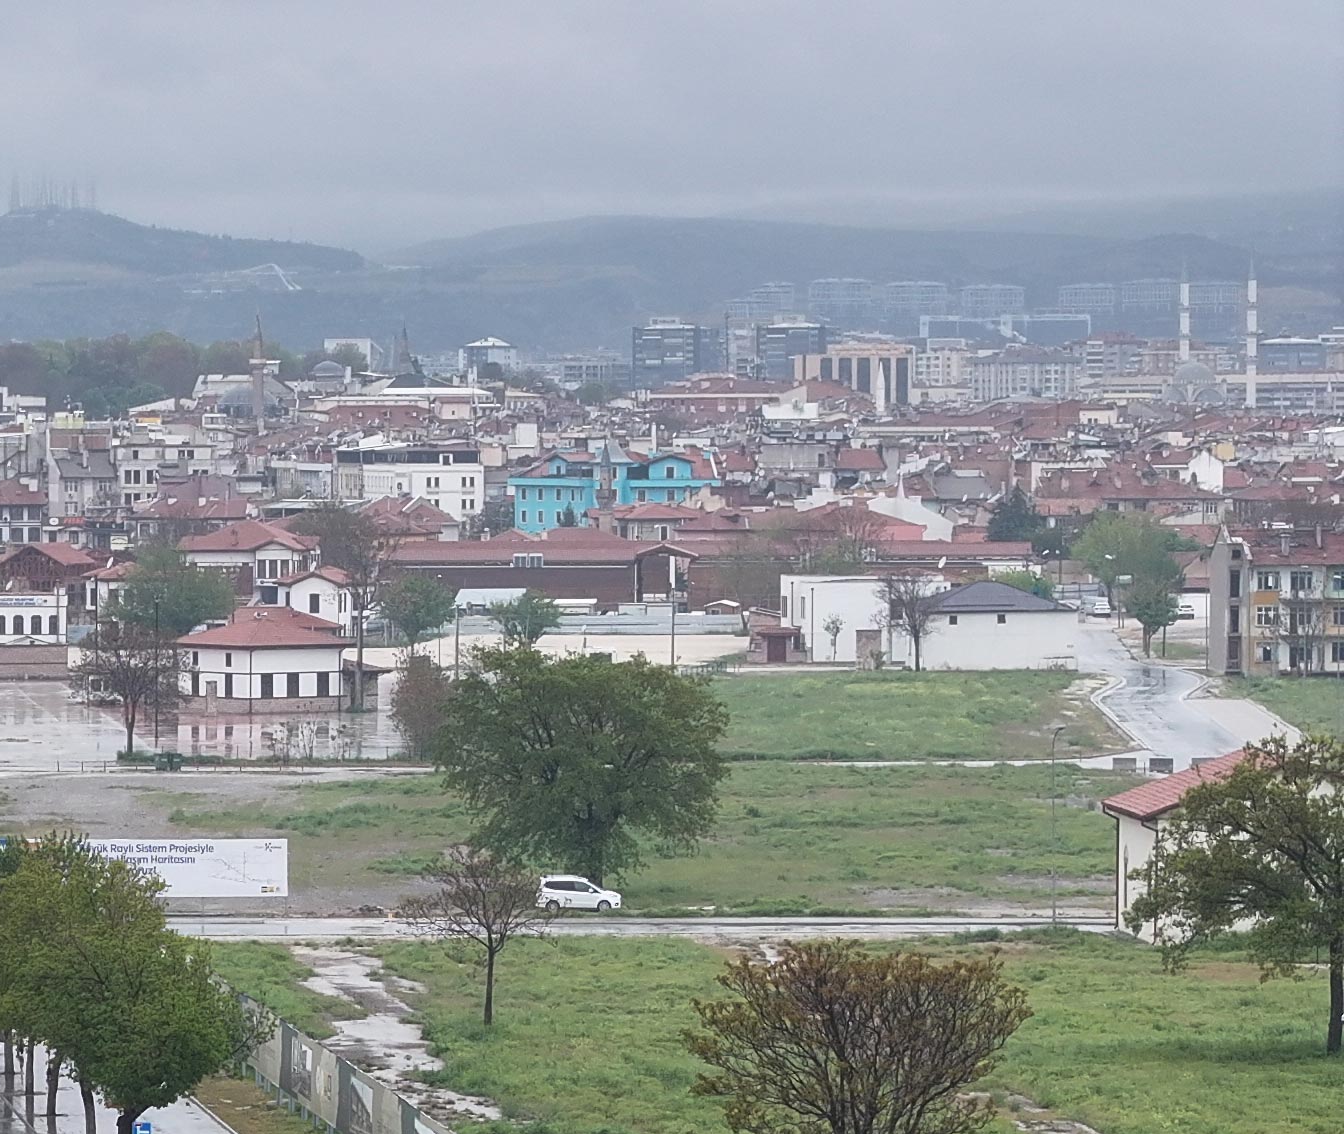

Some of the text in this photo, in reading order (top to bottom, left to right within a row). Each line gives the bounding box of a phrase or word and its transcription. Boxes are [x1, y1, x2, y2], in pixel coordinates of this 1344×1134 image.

[110, 843, 134, 854] Raylı
[136, 843, 166, 853] Sistem
[169, 843, 214, 855] Projesiyle
[150, 854, 196, 864] Haritasını
